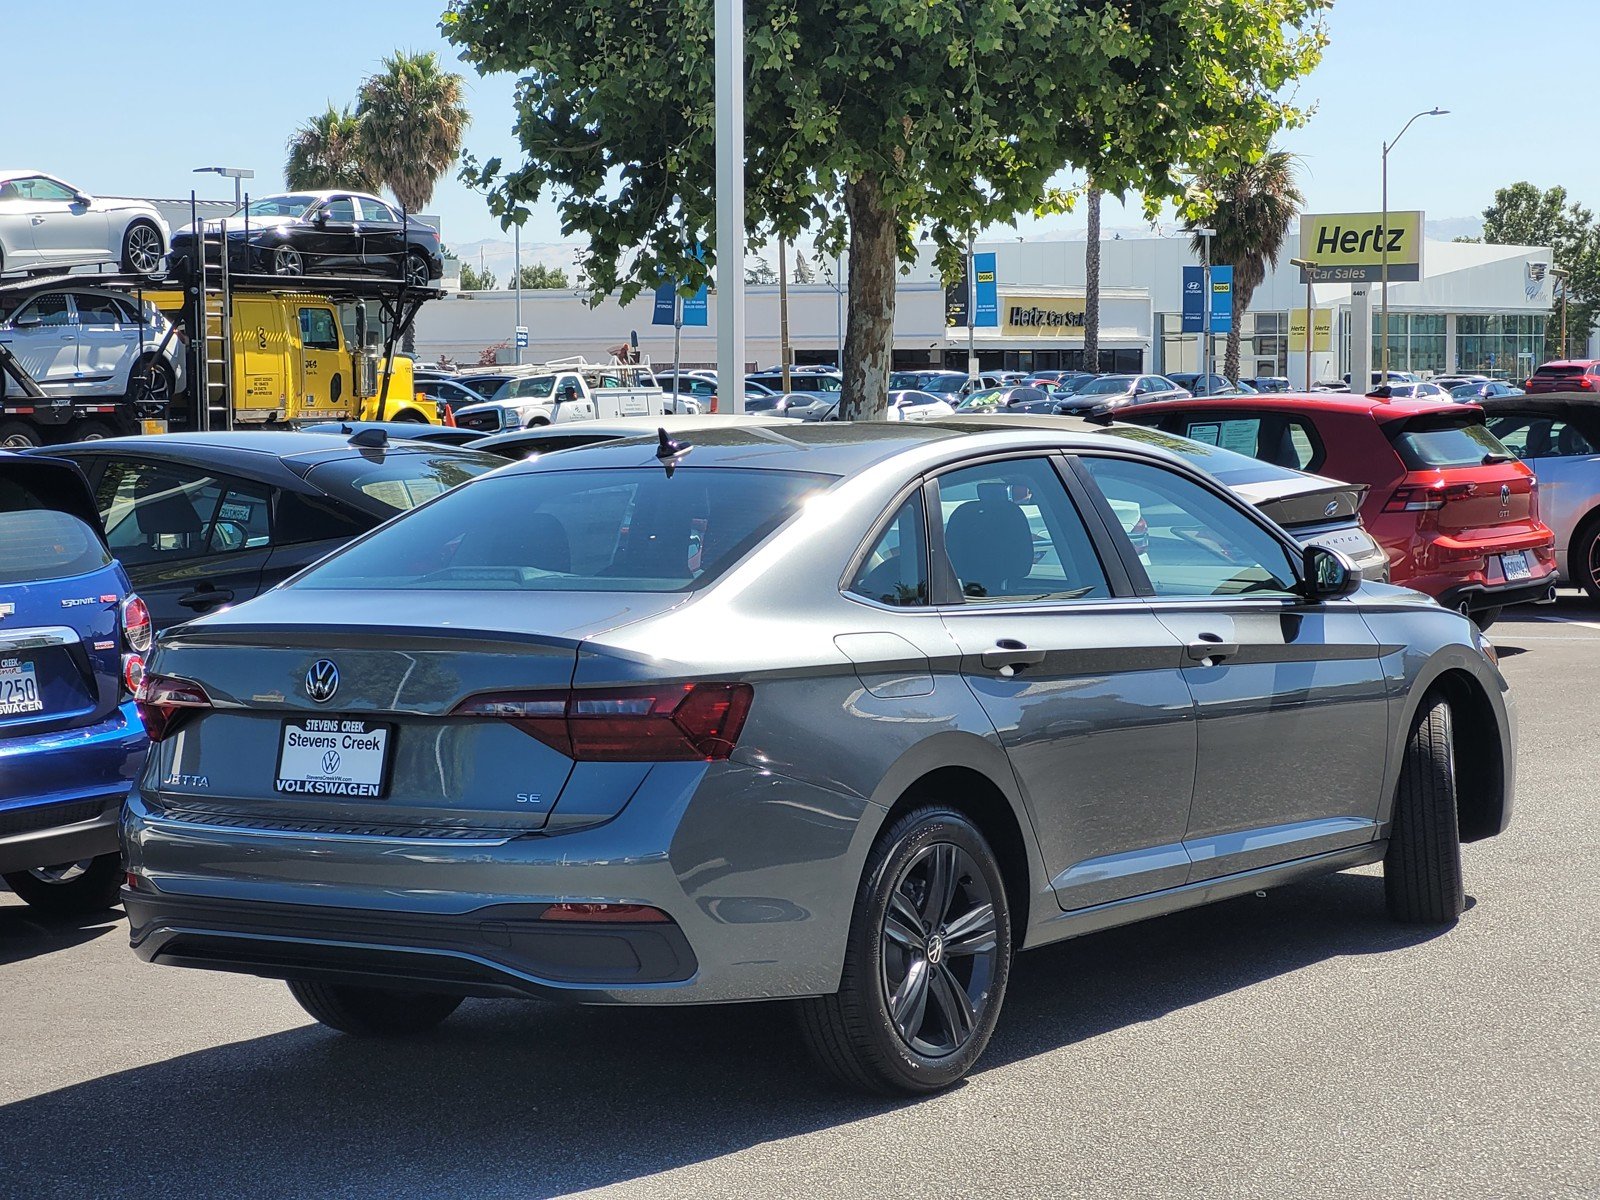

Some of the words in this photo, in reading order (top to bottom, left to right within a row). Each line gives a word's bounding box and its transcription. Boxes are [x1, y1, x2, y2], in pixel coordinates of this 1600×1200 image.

[1317, 225, 1405, 254] Hertz
[1313, 269, 1333, 280] Car
[1335, 268, 1366, 279] Sales
[1009, 306, 1047, 327] Hertz
[1047, 311, 1063, 327] Car
[61, 597, 97, 608] SONIC
[1, 658, 19, 668] CREEK
[305, 719, 339, 732] STEVENS
[341, 720, 365, 733] CREEK
[288, 732, 337, 749] Stevens
[341, 734, 380, 751] Creek
[164, 773, 209, 788] JETTA
[276, 779, 380, 797] VOLKSWAGEN
[516, 793, 541, 803] SE
